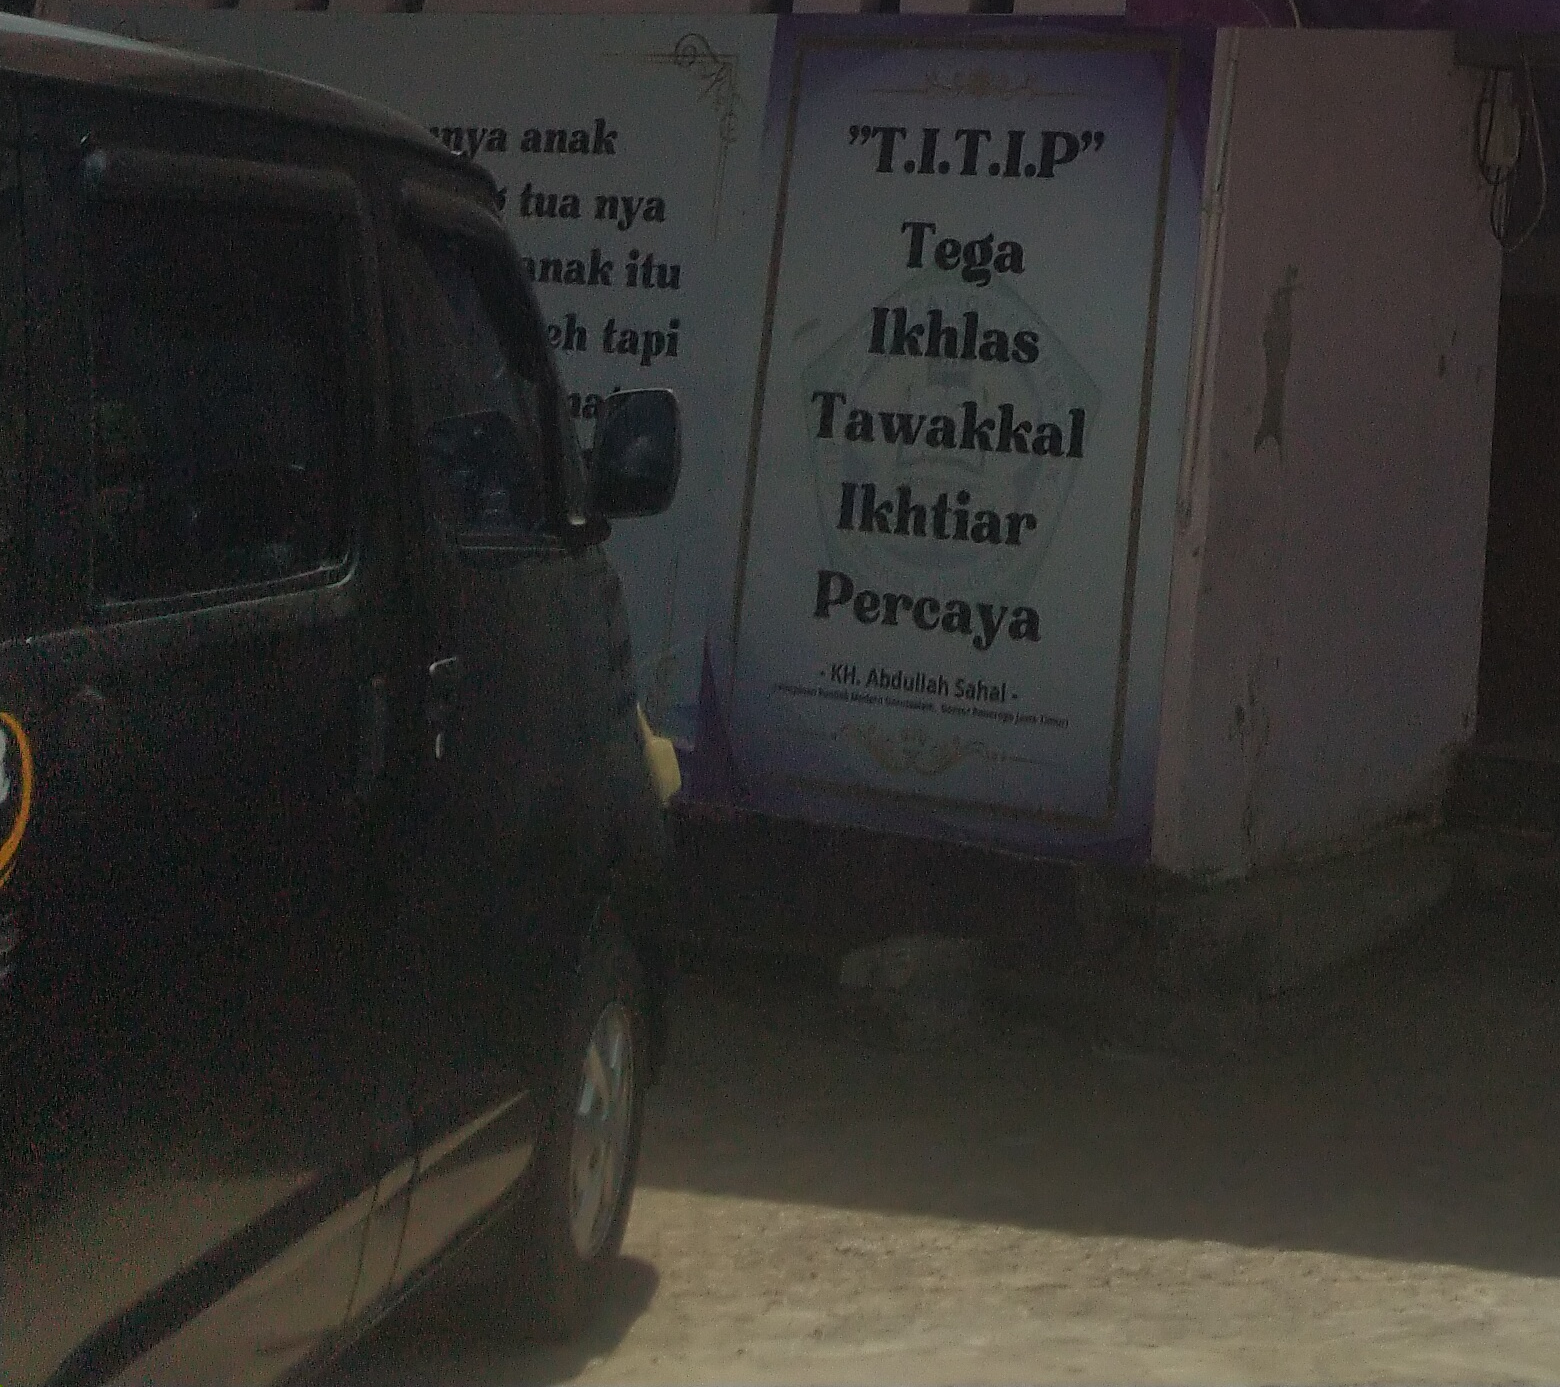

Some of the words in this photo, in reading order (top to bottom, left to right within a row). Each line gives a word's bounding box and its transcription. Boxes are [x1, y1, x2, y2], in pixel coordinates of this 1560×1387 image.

[430, 126, 507, 160] nya
[520, 118, 618, 155] anak
[520, 182, 581, 219] tua
[595, 193, 667, 231] nya
[626, 249, 681, 289] itu
[901, 221, 1025, 287] Tega
[603, 318, 680, 366] tapi
[868, 306, 1040, 364] Ikhlas
[811, 390, 1086, 458] Tawakkal
[836, 481, 1037, 546] Ikhtiar
[813, 569, 1041, 651] Percaya
[830, 664, 861, 686] KH.
[865, 667, 949, 697] Abdullah
[954, 677, 1006, 703] Sahal
